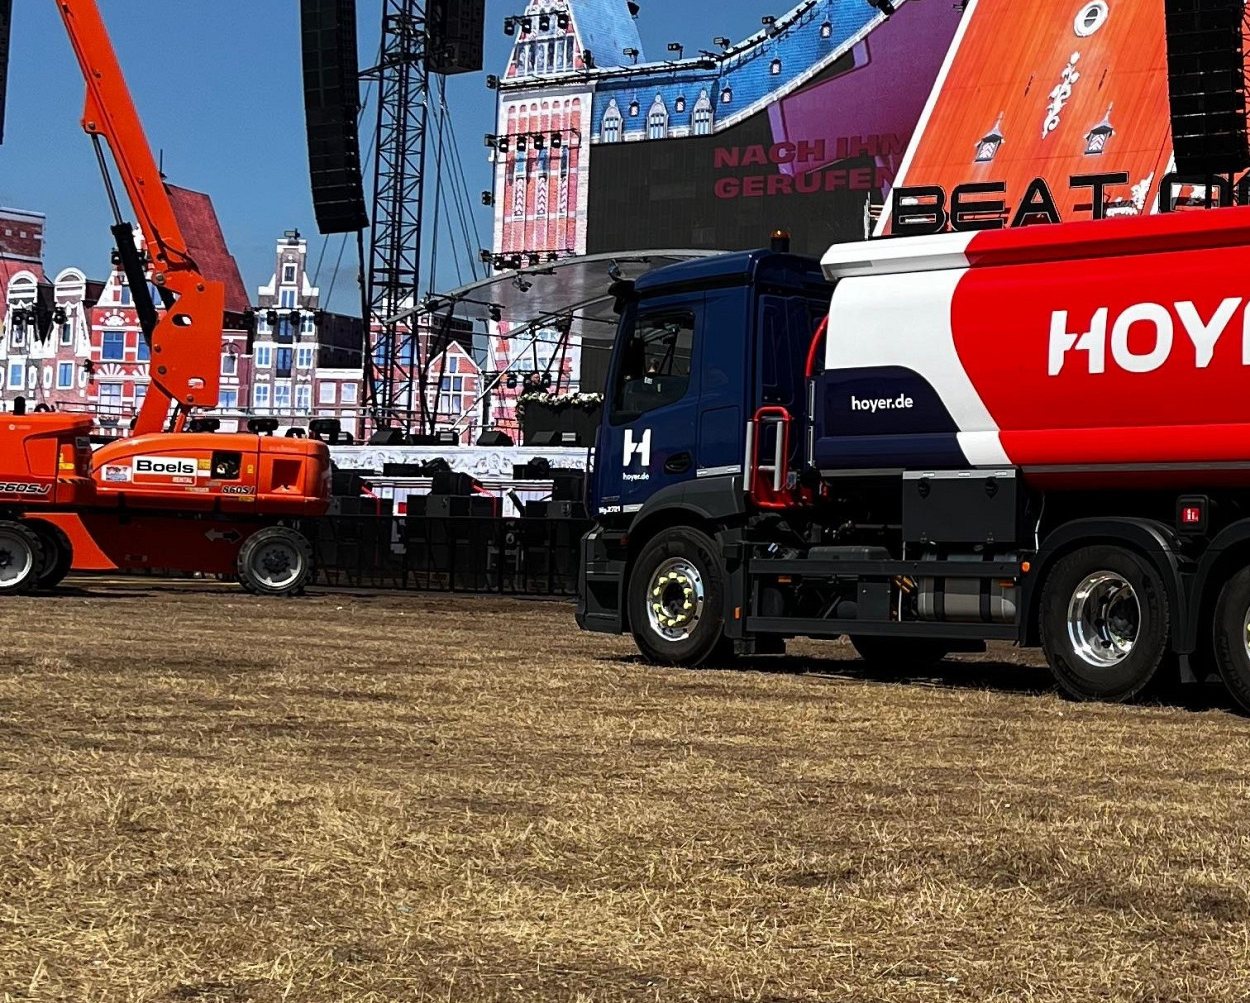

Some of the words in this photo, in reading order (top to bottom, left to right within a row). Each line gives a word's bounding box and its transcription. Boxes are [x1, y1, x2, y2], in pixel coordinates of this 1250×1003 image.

[713, 138, 826, 169] NACH
[892, 171, 1130, 236] BEAT
[850, 392, 914, 413] hoyer.de
[136, 459, 195, 474] Boels
[622, 472, 650, 482] hoyer.de
